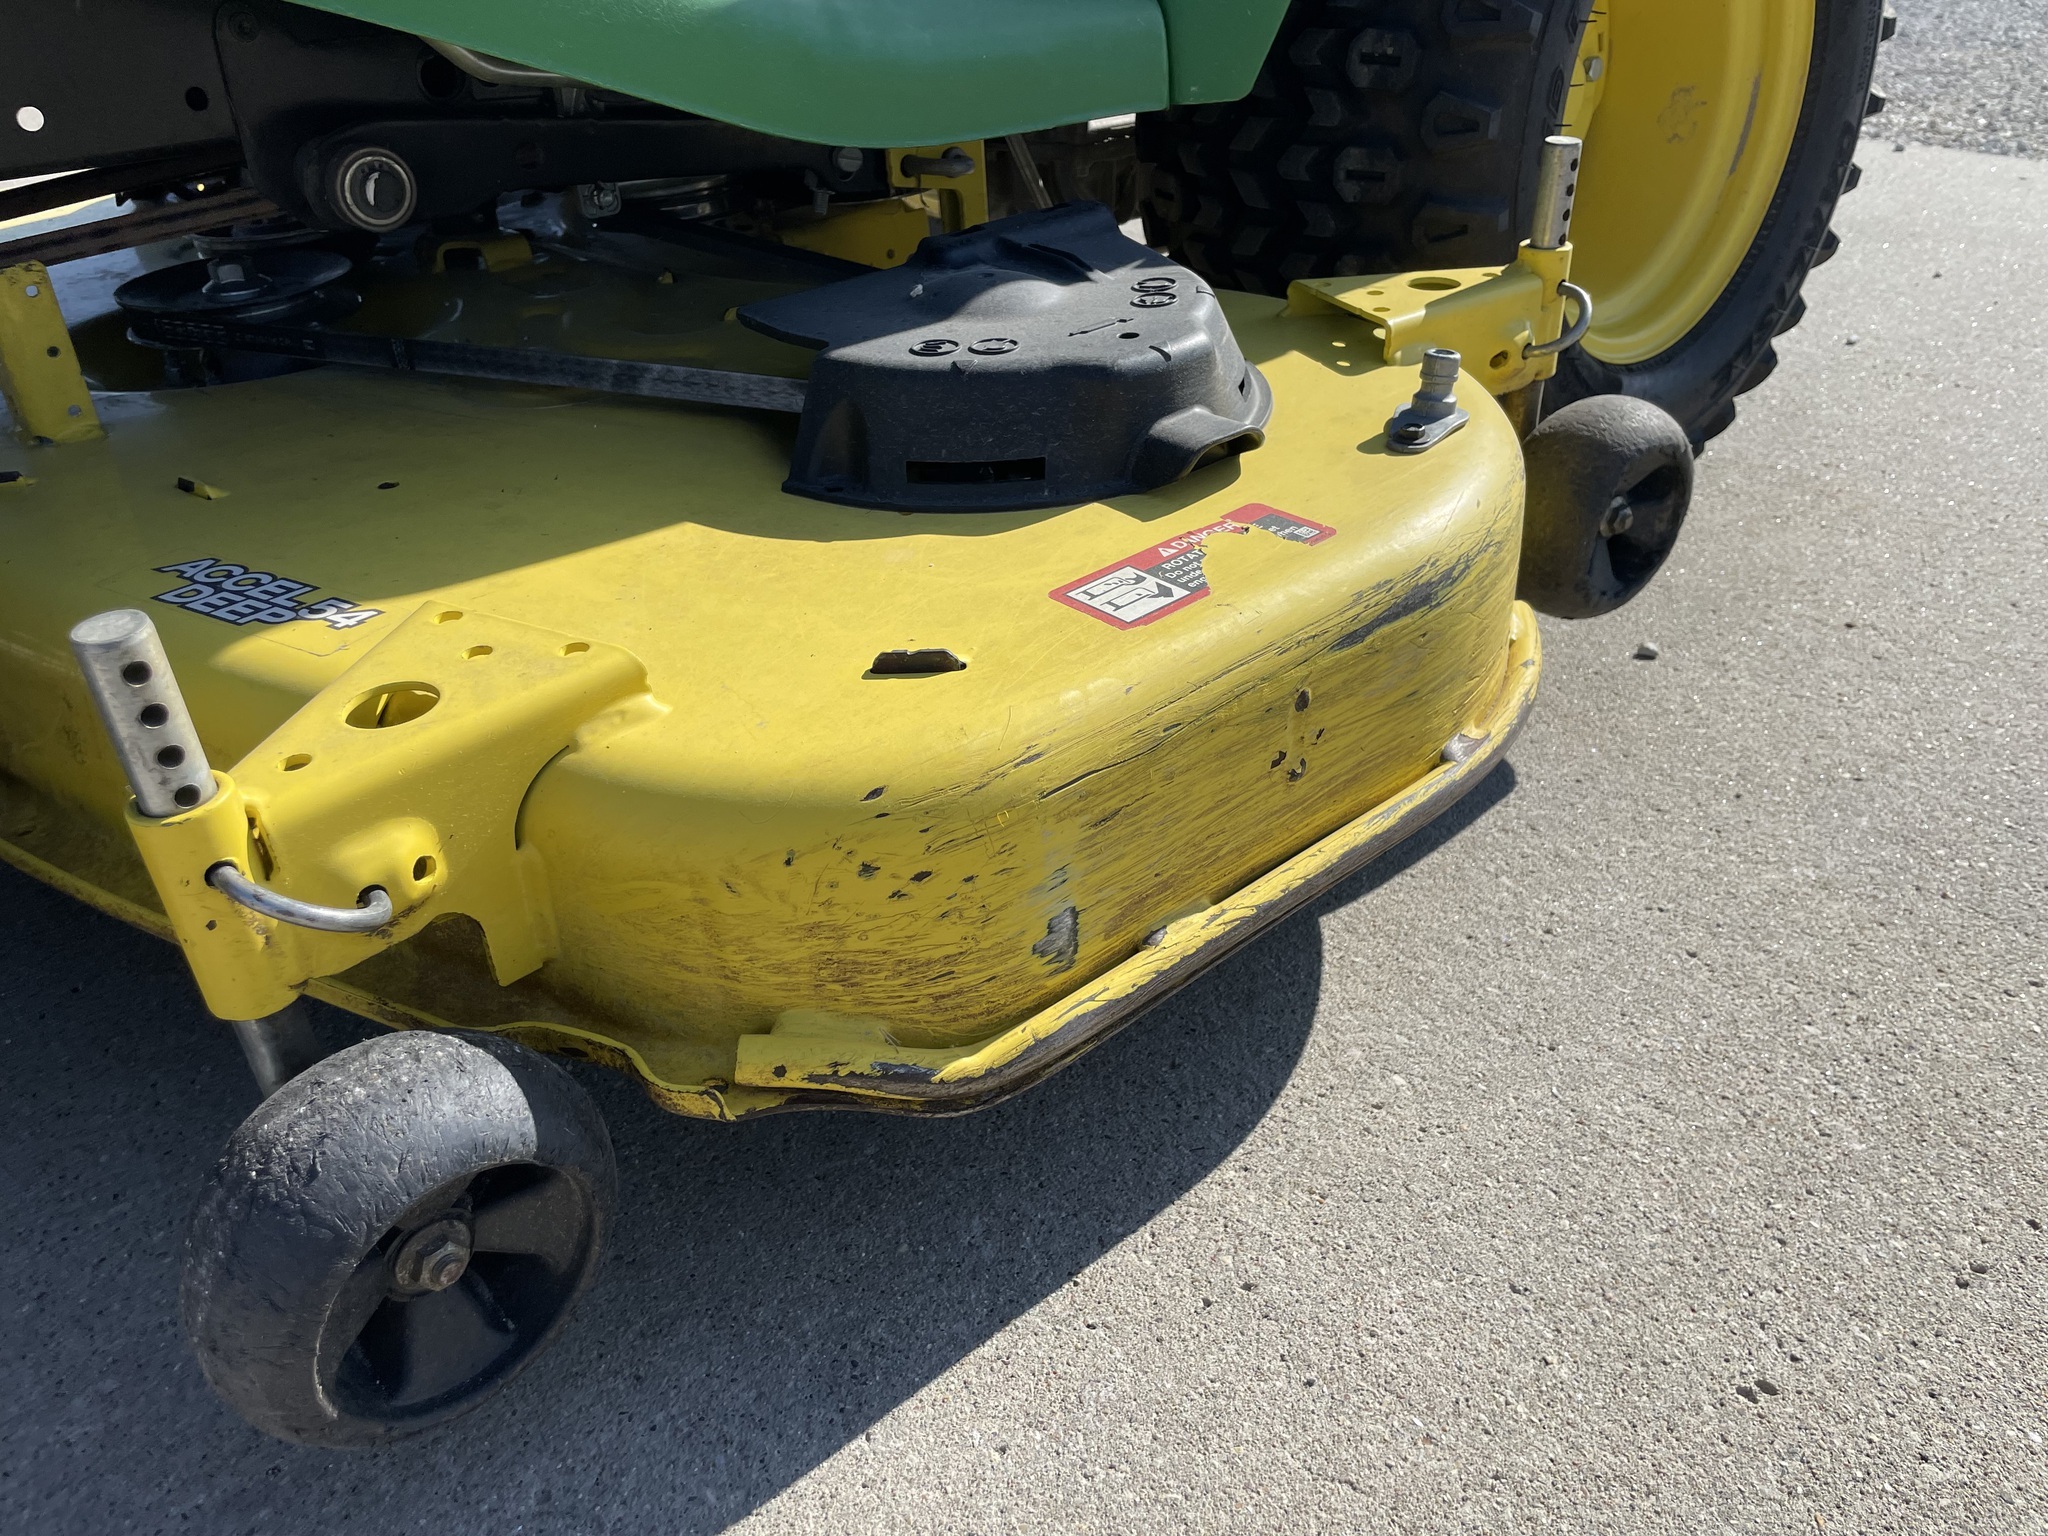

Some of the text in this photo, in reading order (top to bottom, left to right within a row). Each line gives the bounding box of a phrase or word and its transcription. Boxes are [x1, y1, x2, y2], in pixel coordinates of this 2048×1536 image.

[1161, 549, 1204, 570] ROTAT
[1165, 569, 1183, 579] Do
[1182, 561, 1201, 572] not
[154, 558, 318, 608] ACCEL
[153, 583, 383, 629] DEEP 54
